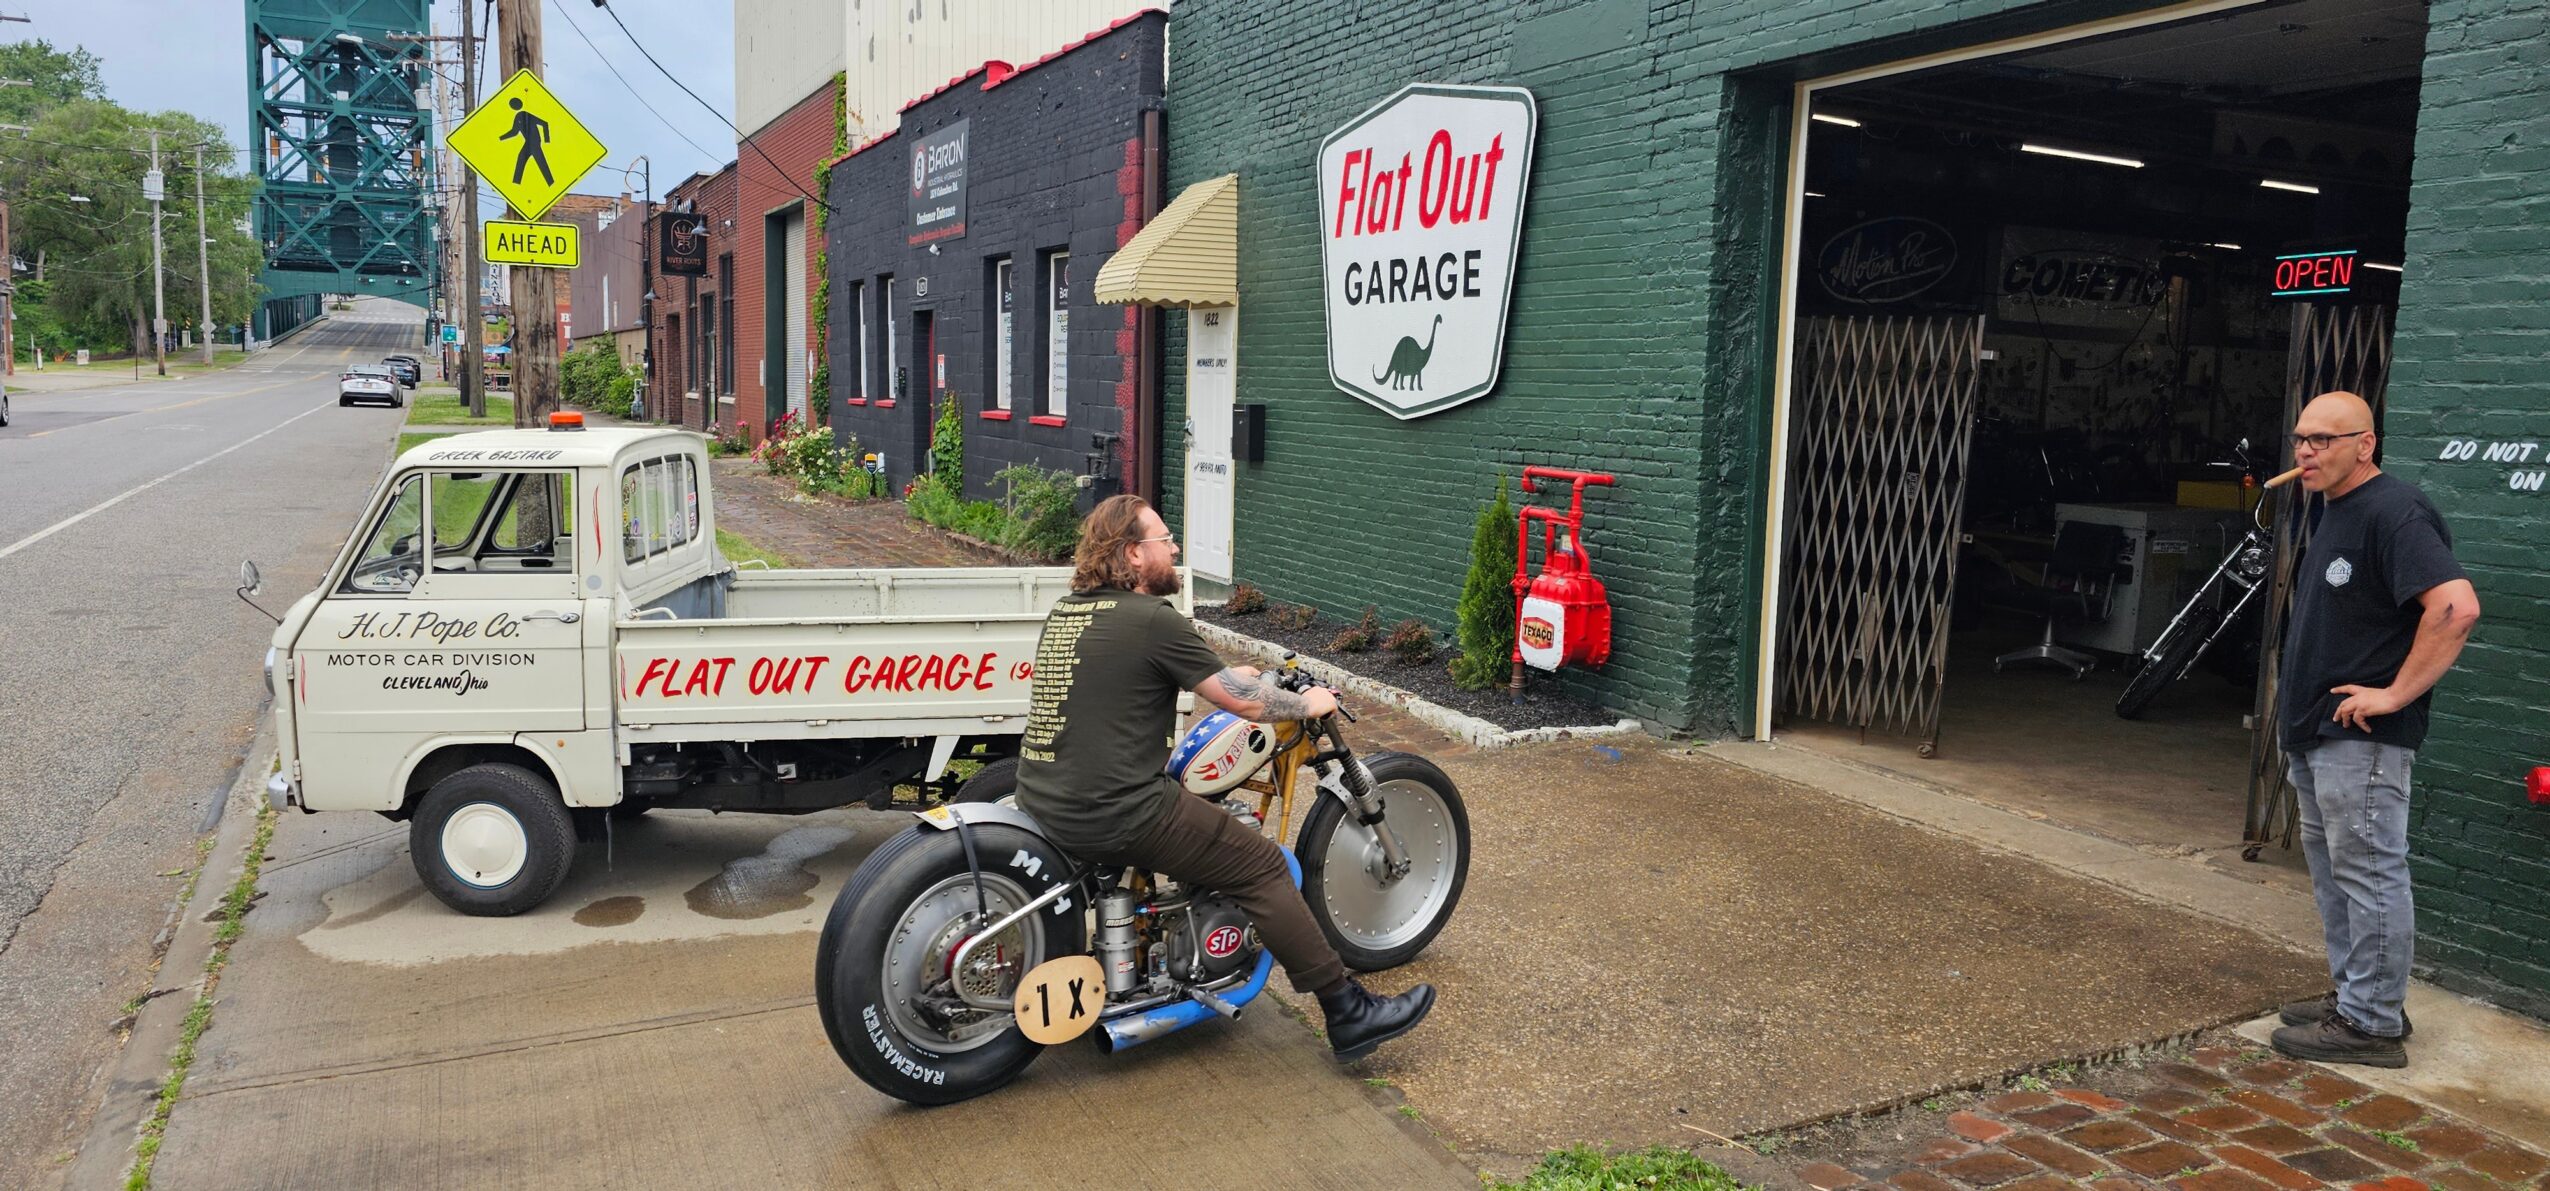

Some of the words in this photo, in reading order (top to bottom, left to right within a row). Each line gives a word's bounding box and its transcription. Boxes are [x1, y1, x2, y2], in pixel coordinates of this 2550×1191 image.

[928, 132, 964, 173] BARON
[1335, 147, 1412, 238] Flat
[1418, 129, 1504, 228] Out
[916, 212, 936, 226] Customer
[936, 206, 956, 220] Entrance
[497, 233, 567, 255] AHEAD
[1830, 231, 1899, 287] Motion
[1899, 231, 1944, 272] Pro
[1344, 249, 1481, 306] GARAGE
[2275, 256, 2354, 290] OPEN
[1204, 312, 1219, 327] 1822
[1197, 358, 1214, 368] MEMBERS
[429, 450, 486, 461] GREEK
[488, 450, 562, 461] BASTARD
[2439, 440, 2477, 461] DO
[2482, 442, 2539, 463] NOT
[2509, 471, 2547, 491] ON
[410, 611, 478, 645] Pope
[484, 612, 521, 638] Co.
[1524, 624, 1552, 641] TEXACO
[327, 654, 396, 666] MOTOR
[404, 654, 444, 666] CAR
[452, 653, 535, 666] DIVISION
[455, 669, 489, 696] Ohio
[635, 657, 736, 698] FLAT
[748, 656, 830, 696] OUT
[845, 652, 997, 694] GARAGE
[1210, 929, 1238, 951] STP
[862, 1003, 945, 1086] RACEMASTER
